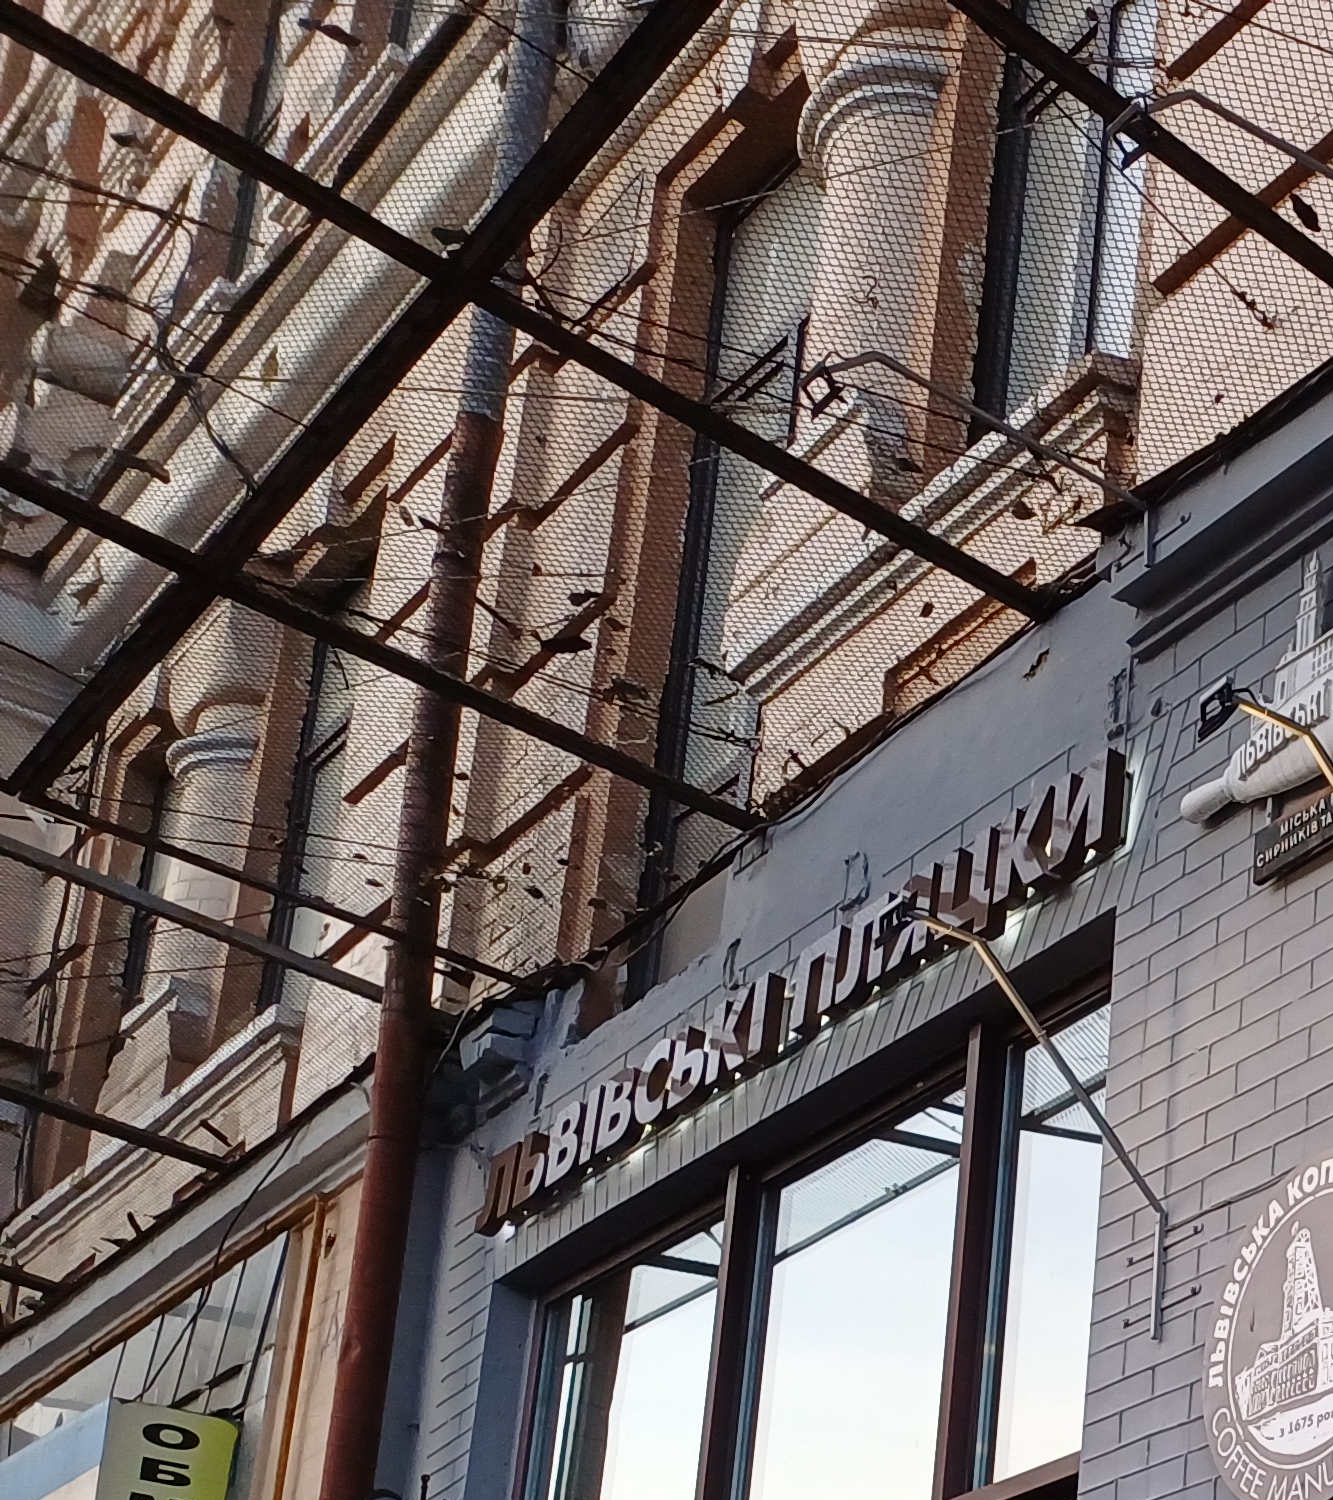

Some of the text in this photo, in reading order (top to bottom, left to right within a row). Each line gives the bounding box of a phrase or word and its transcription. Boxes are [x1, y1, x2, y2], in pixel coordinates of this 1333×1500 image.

[1237, 678, 1331, 781] ЛЬВІВЬКІ
[1256, 822, 1319, 868] СИРНИКІВ
[1320, 814, 1333, 829] ТА
[1279, 798, 1327, 837] МІСЬКА
[475, 972, 787, 1237] ЛЬВІВСЬКІ
[1208, 1200, 1282, 1388] ЛЬВІВСЬКА
[1212, 1407, 1268, 1500] COFFEE
[1288, 1413, 1314, 1435] 1675
